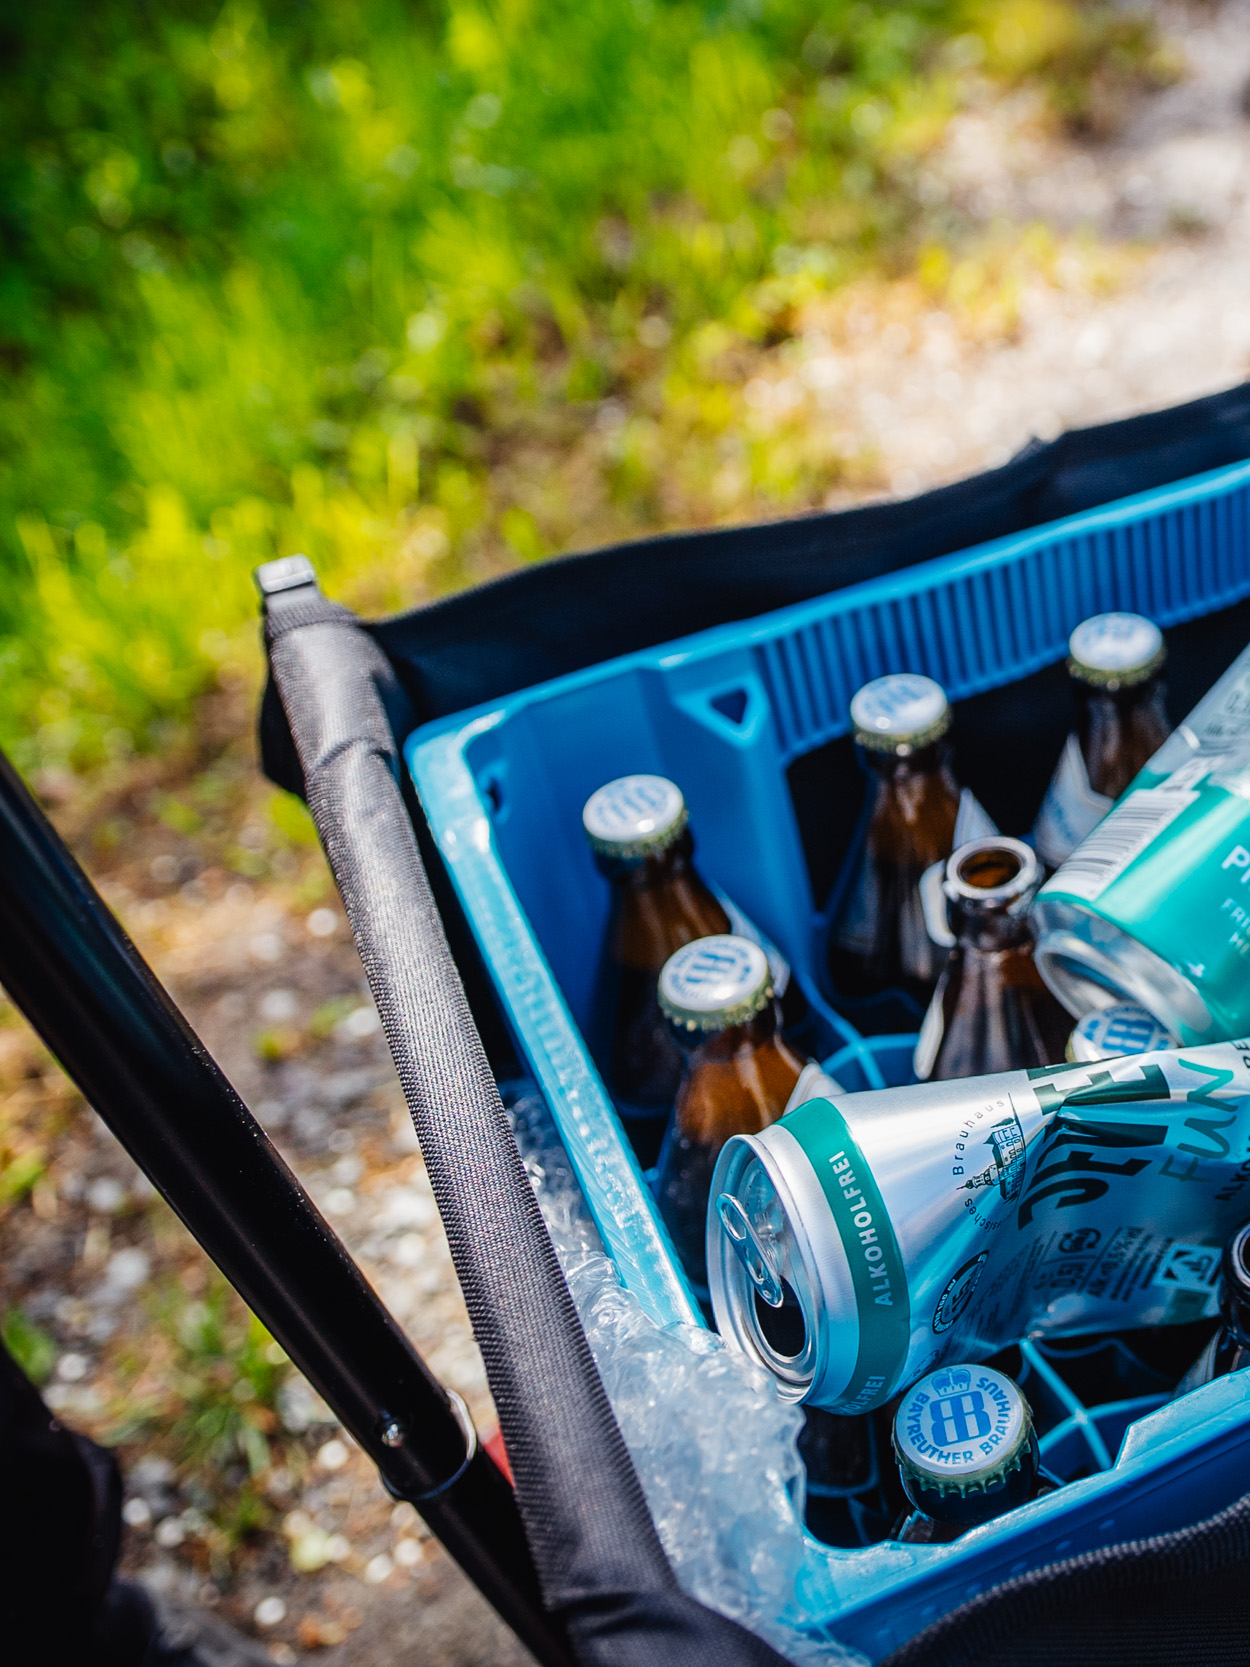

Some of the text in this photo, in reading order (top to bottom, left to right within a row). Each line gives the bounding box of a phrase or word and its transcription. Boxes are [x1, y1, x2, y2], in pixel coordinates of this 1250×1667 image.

[952, 1099, 1005, 1176] Brauhaus
[1158, 1058, 1239, 1183] FUN
[828, 1150, 894, 1307] ALKOHOLFREI
[907, 1377, 1011, 1465] BAYREUTHER BRAUHAUS
